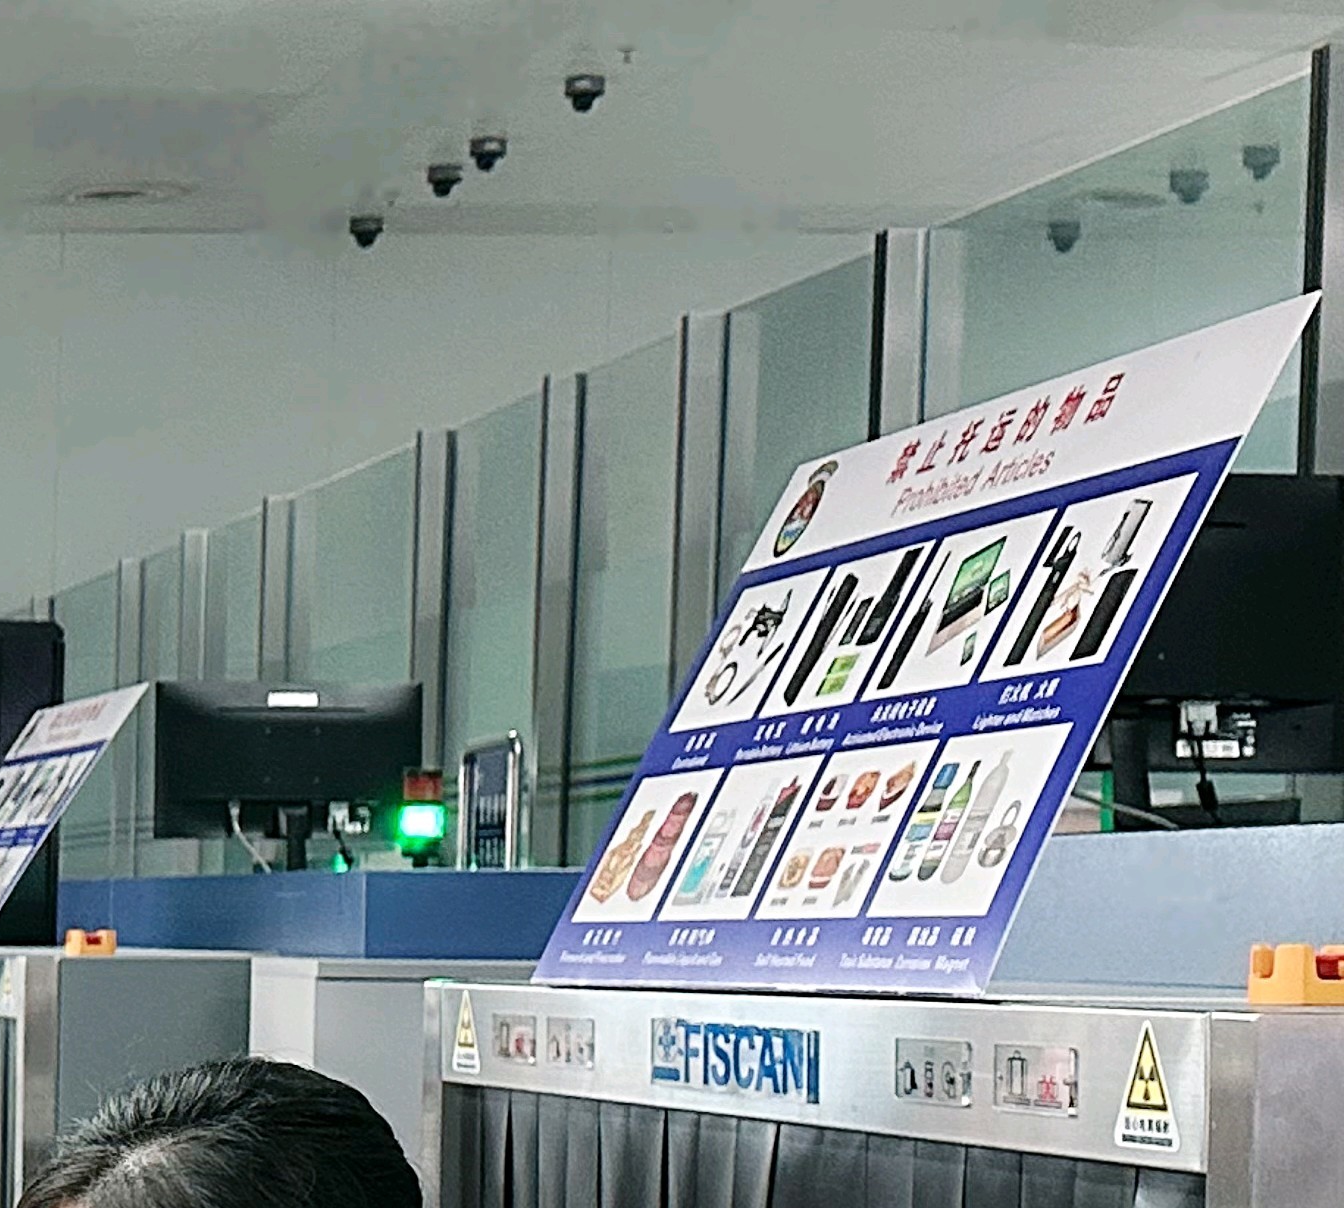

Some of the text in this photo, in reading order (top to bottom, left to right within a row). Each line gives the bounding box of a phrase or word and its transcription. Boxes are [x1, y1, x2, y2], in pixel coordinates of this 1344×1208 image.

[886, 373, 1125, 484] 禁止托运的物品
[891, 450, 1055, 517] Prohibited Articles
[683, 1022, 805, 1096] FISCAN
